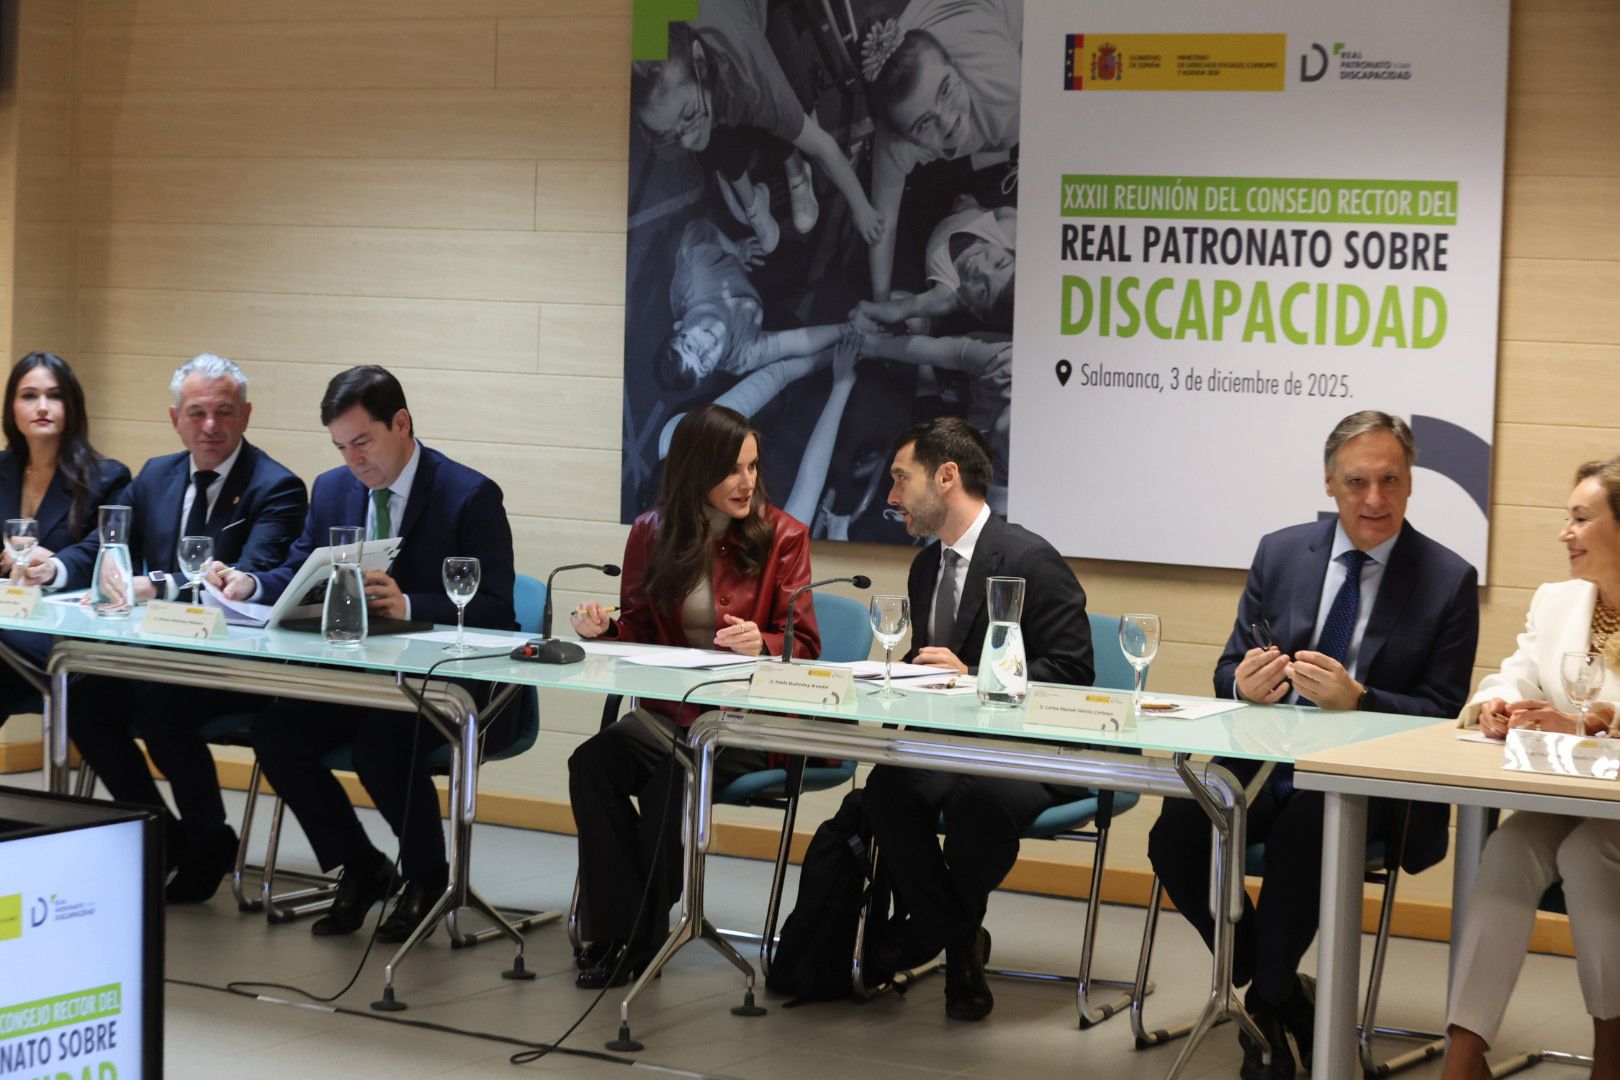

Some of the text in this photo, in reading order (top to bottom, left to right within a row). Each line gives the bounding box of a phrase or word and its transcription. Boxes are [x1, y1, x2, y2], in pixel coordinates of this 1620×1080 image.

[1340, 70, 1412, 80] DISCAPACIDAD
[1063, 178, 1457, 217] XXXII REUNIÓN DEL CONSEJO RECTOR DEL
[1061, 223, 1449, 272] REAL PATRONATO SOBRE
[1060, 274, 1449, 349] DISCAPACIDAD
[1080, 362, 1353, 398] Salamanca, 3 de diciembre de 2025.
[53, 994, 97, 1022] RECTOR
[99, 989, 118, 1012] DEL
[58, 1020, 117, 1061] SOBRE
